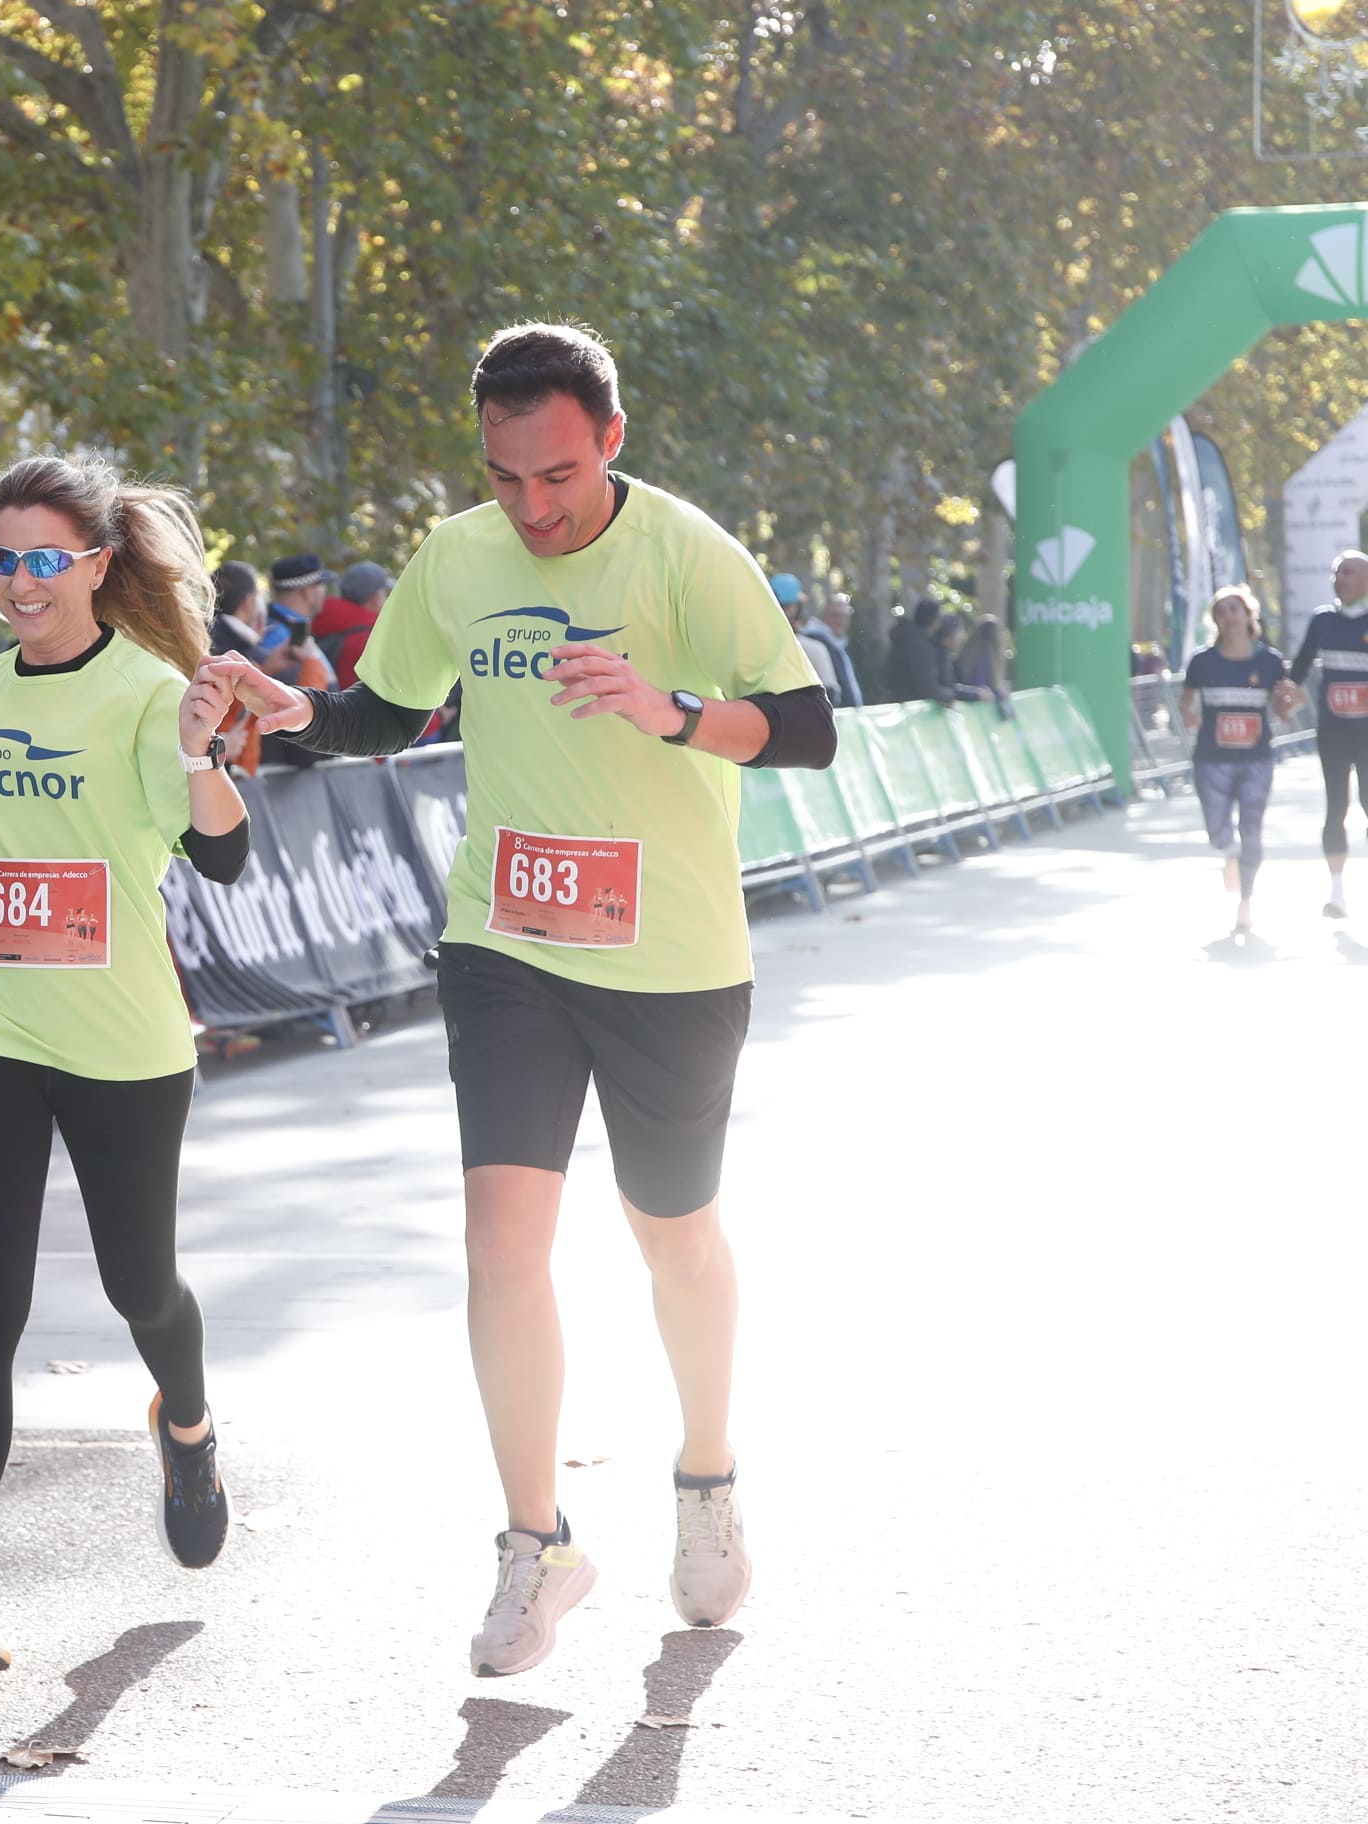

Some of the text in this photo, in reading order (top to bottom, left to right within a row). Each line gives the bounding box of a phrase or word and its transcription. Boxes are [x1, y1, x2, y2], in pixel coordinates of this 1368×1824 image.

[1016, 595, 1113, 632] Unicaja
[507, 628, 551, 643] grupo
[470, 638, 628, 680] elec
[523, 843, 544, 853] Carrera
[545, 846, 554, 854] de
[554, 848, 589, 858] empresas
[592, 849, 619, 858] Adecco
[62, 871, 88, 879] Adecco
[509, 852, 578, 905] 683
